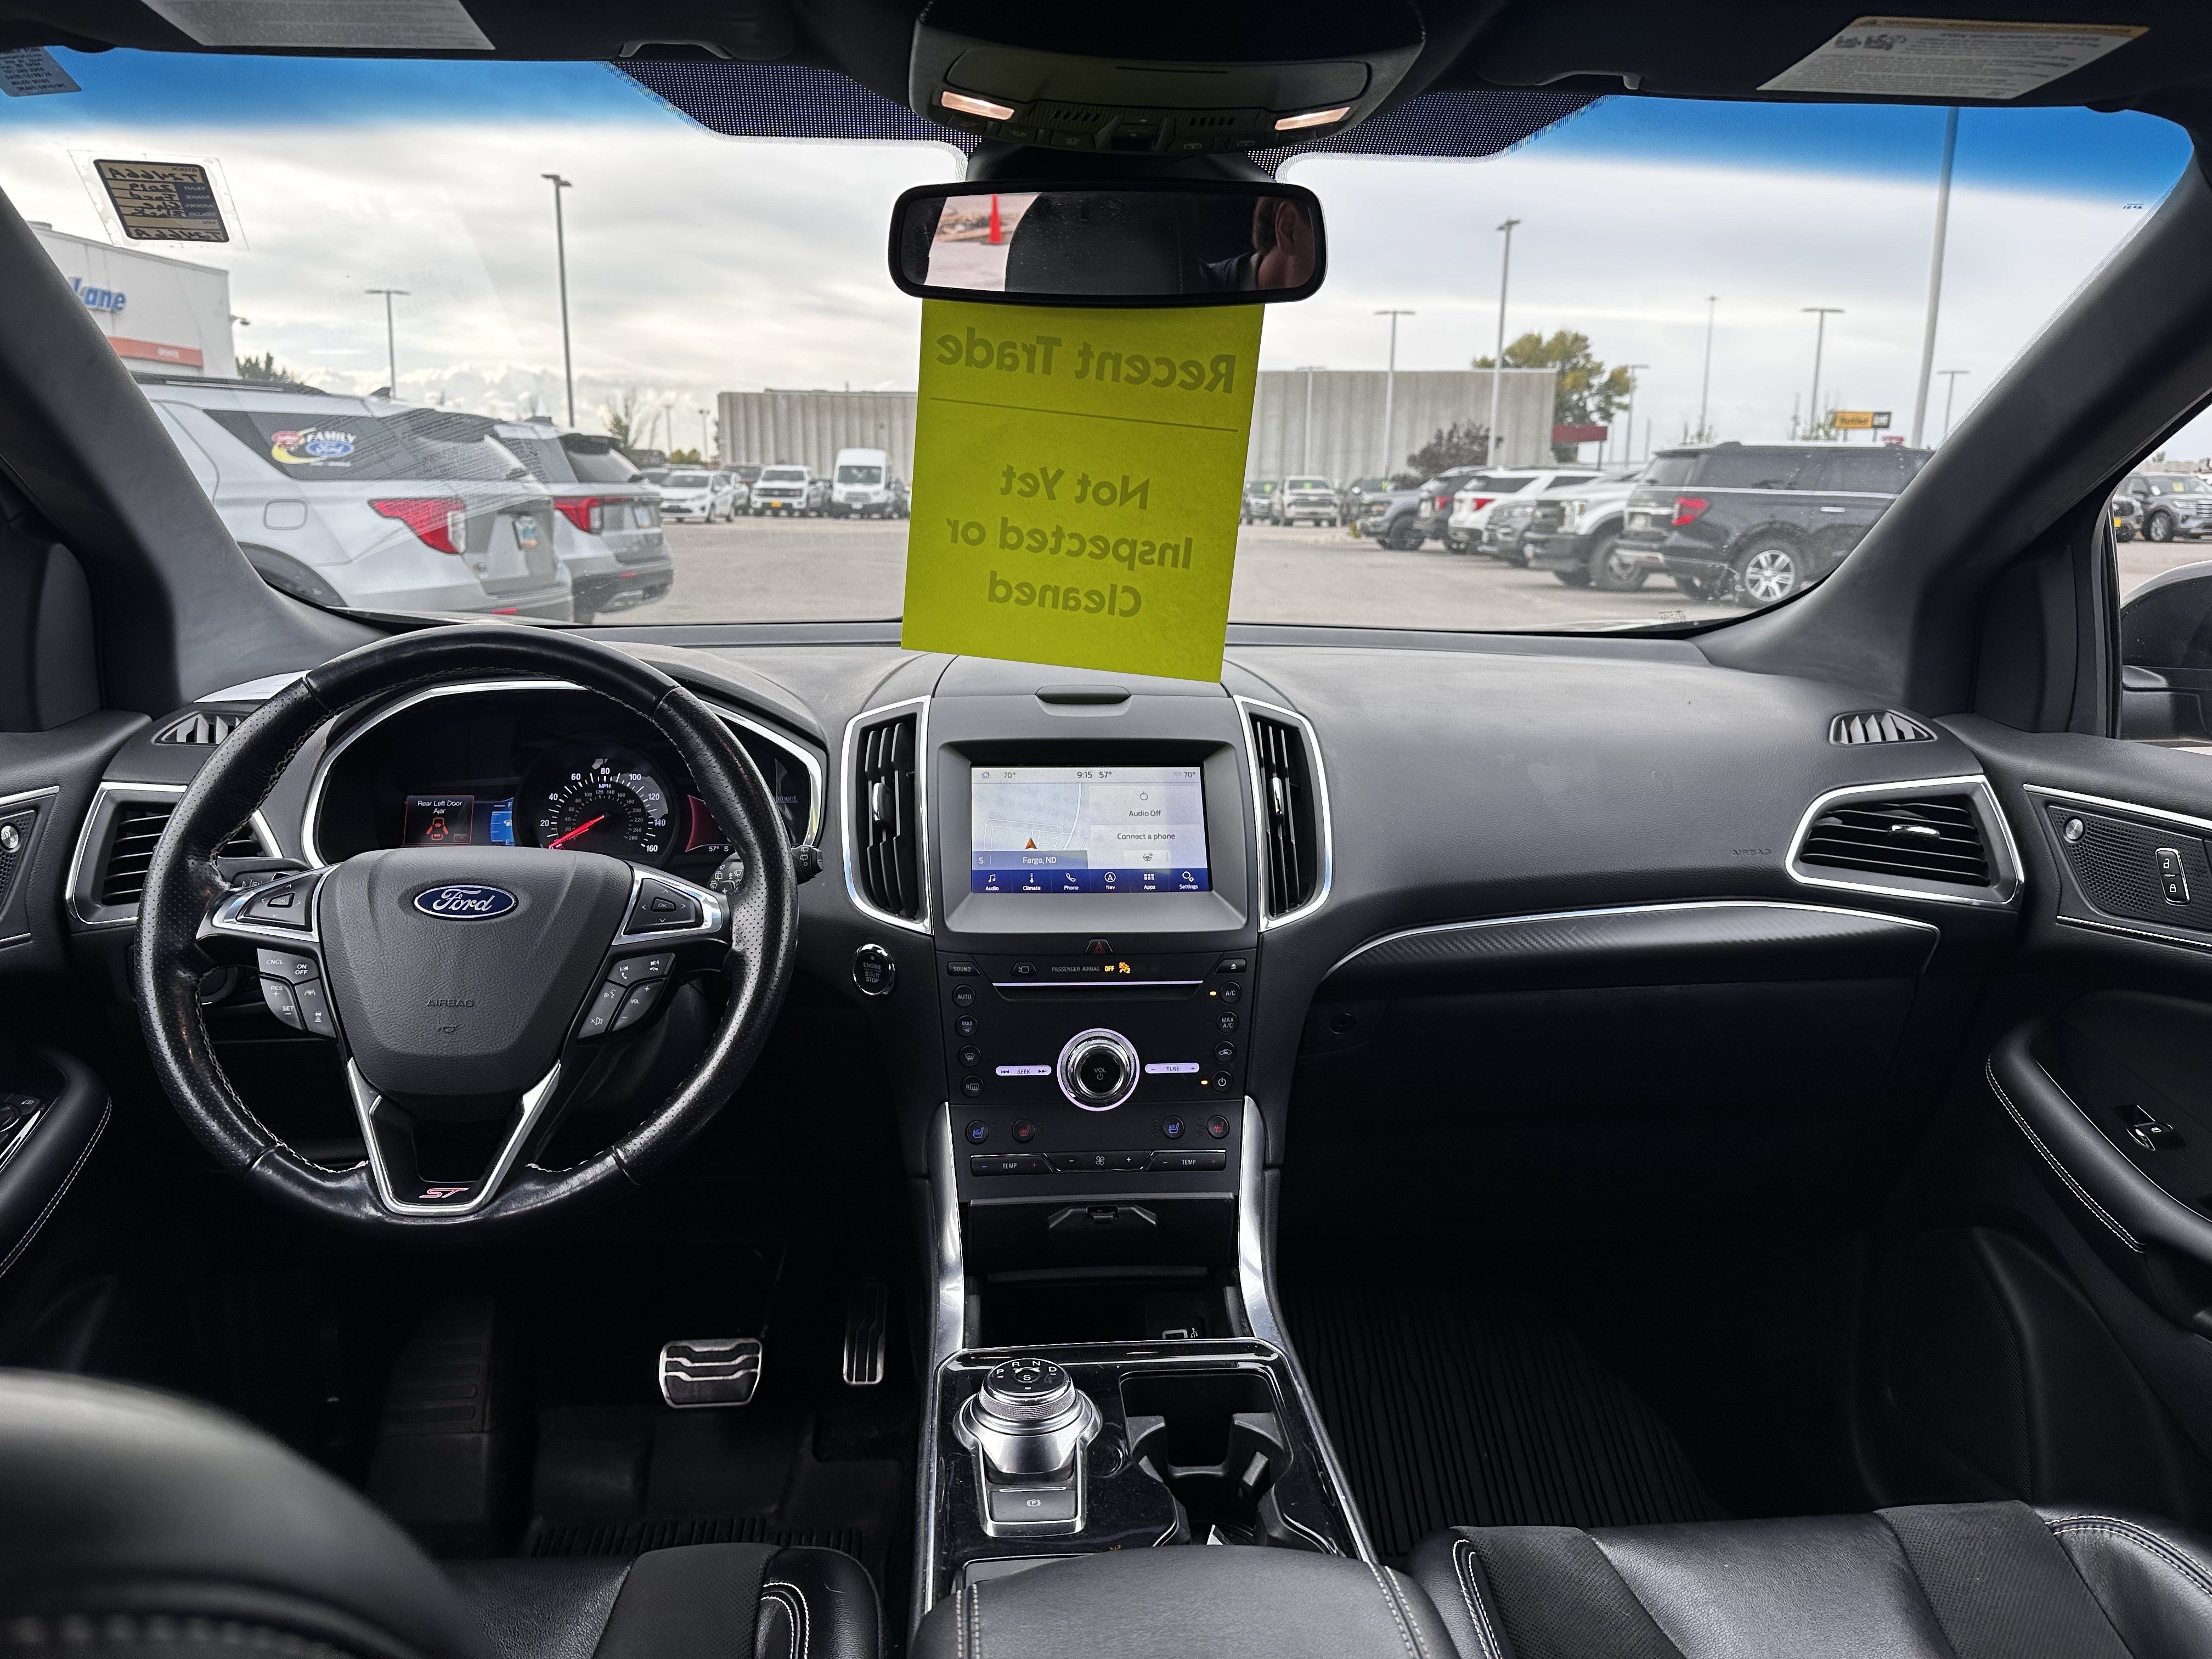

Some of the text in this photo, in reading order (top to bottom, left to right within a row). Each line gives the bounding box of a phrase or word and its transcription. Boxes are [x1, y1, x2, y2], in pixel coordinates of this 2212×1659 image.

[307, 431, 357, 444] FAMILY
[1153, 833, 1176, 841] phone
[1023, 856, 1045, 865] Fargo,
[432, 888, 495, 911] Ford
[863, 962, 882, 970] ENGINE
[426, 998, 475, 1008] AIRBAG
[419, 1188, 470, 1198] ST
